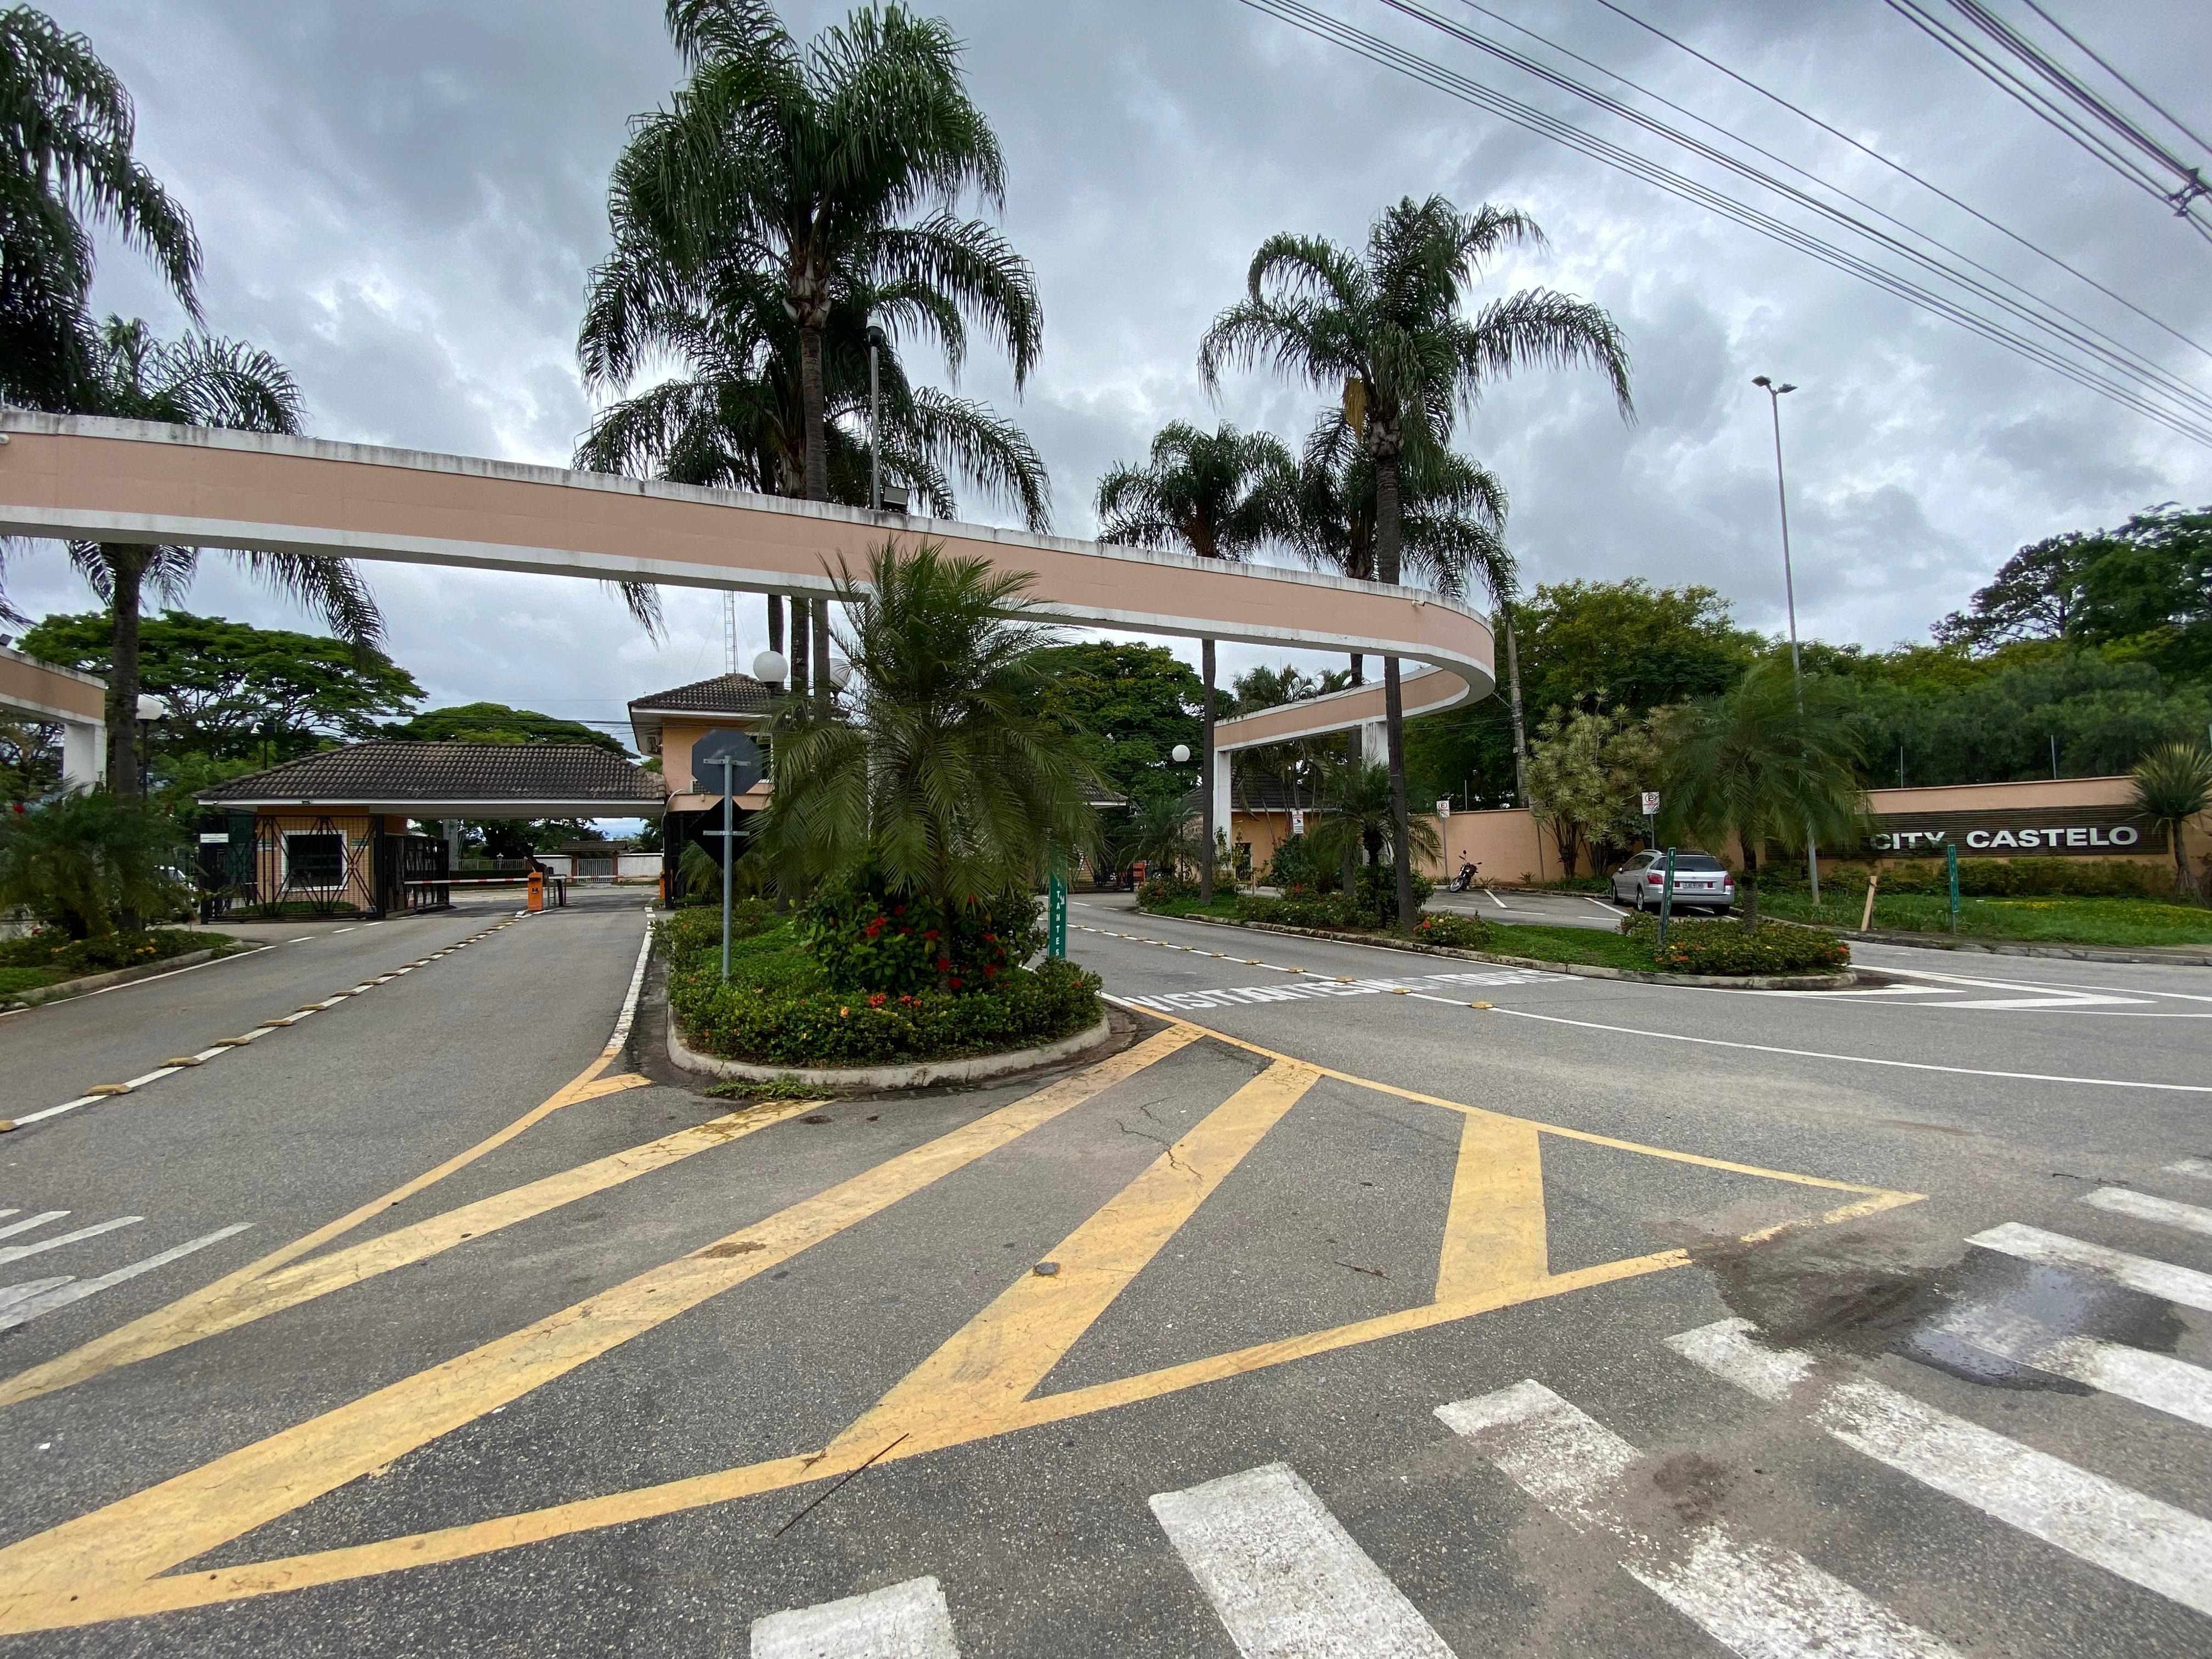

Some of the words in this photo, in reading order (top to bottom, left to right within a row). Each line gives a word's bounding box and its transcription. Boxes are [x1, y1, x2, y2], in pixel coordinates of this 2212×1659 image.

[1870, 831, 1945, 850] CITY
[1966, 827, 2138, 848] CASTELO
[1122, 981, 1381, 1012] VISITANTES
